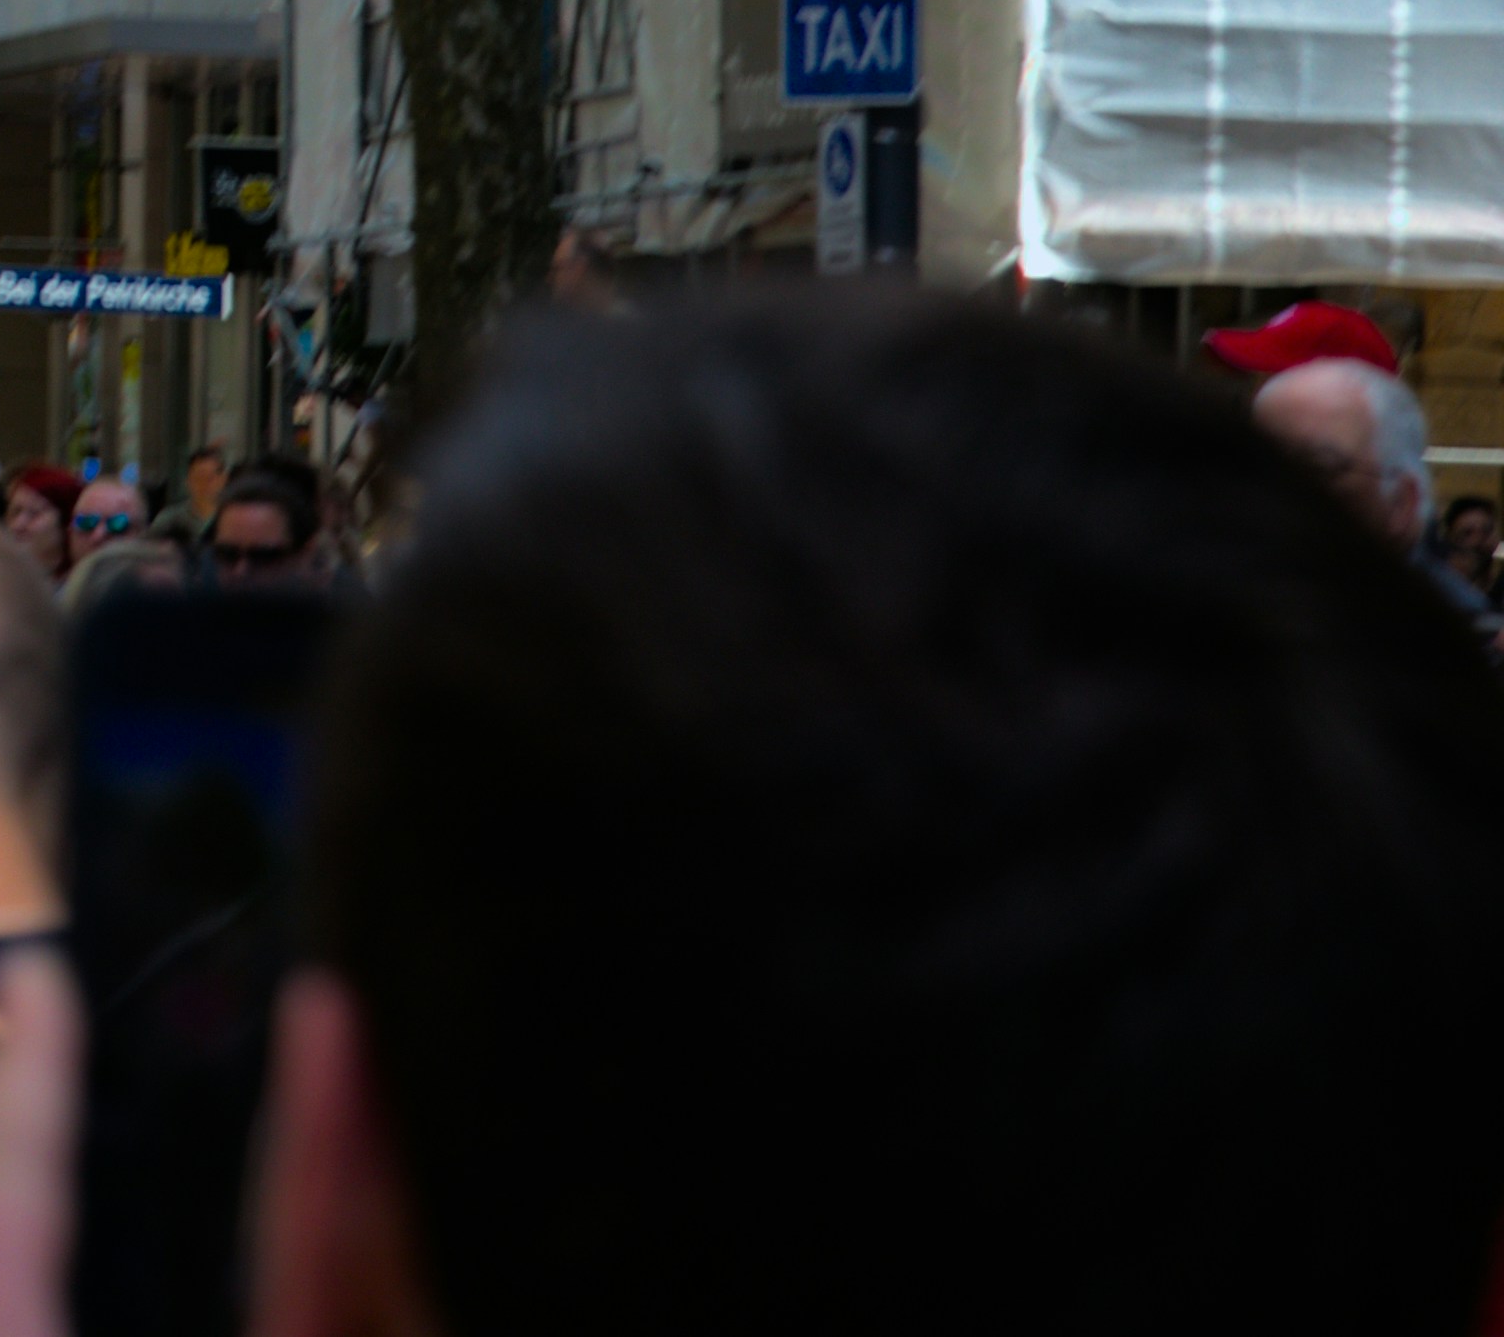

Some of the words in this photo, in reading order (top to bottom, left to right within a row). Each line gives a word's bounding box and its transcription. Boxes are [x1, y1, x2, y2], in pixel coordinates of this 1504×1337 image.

[795, 4, 905, 75] TAXI
[40, 273, 81, 308] der
[86, 274, 212, 313] Petrikirche
